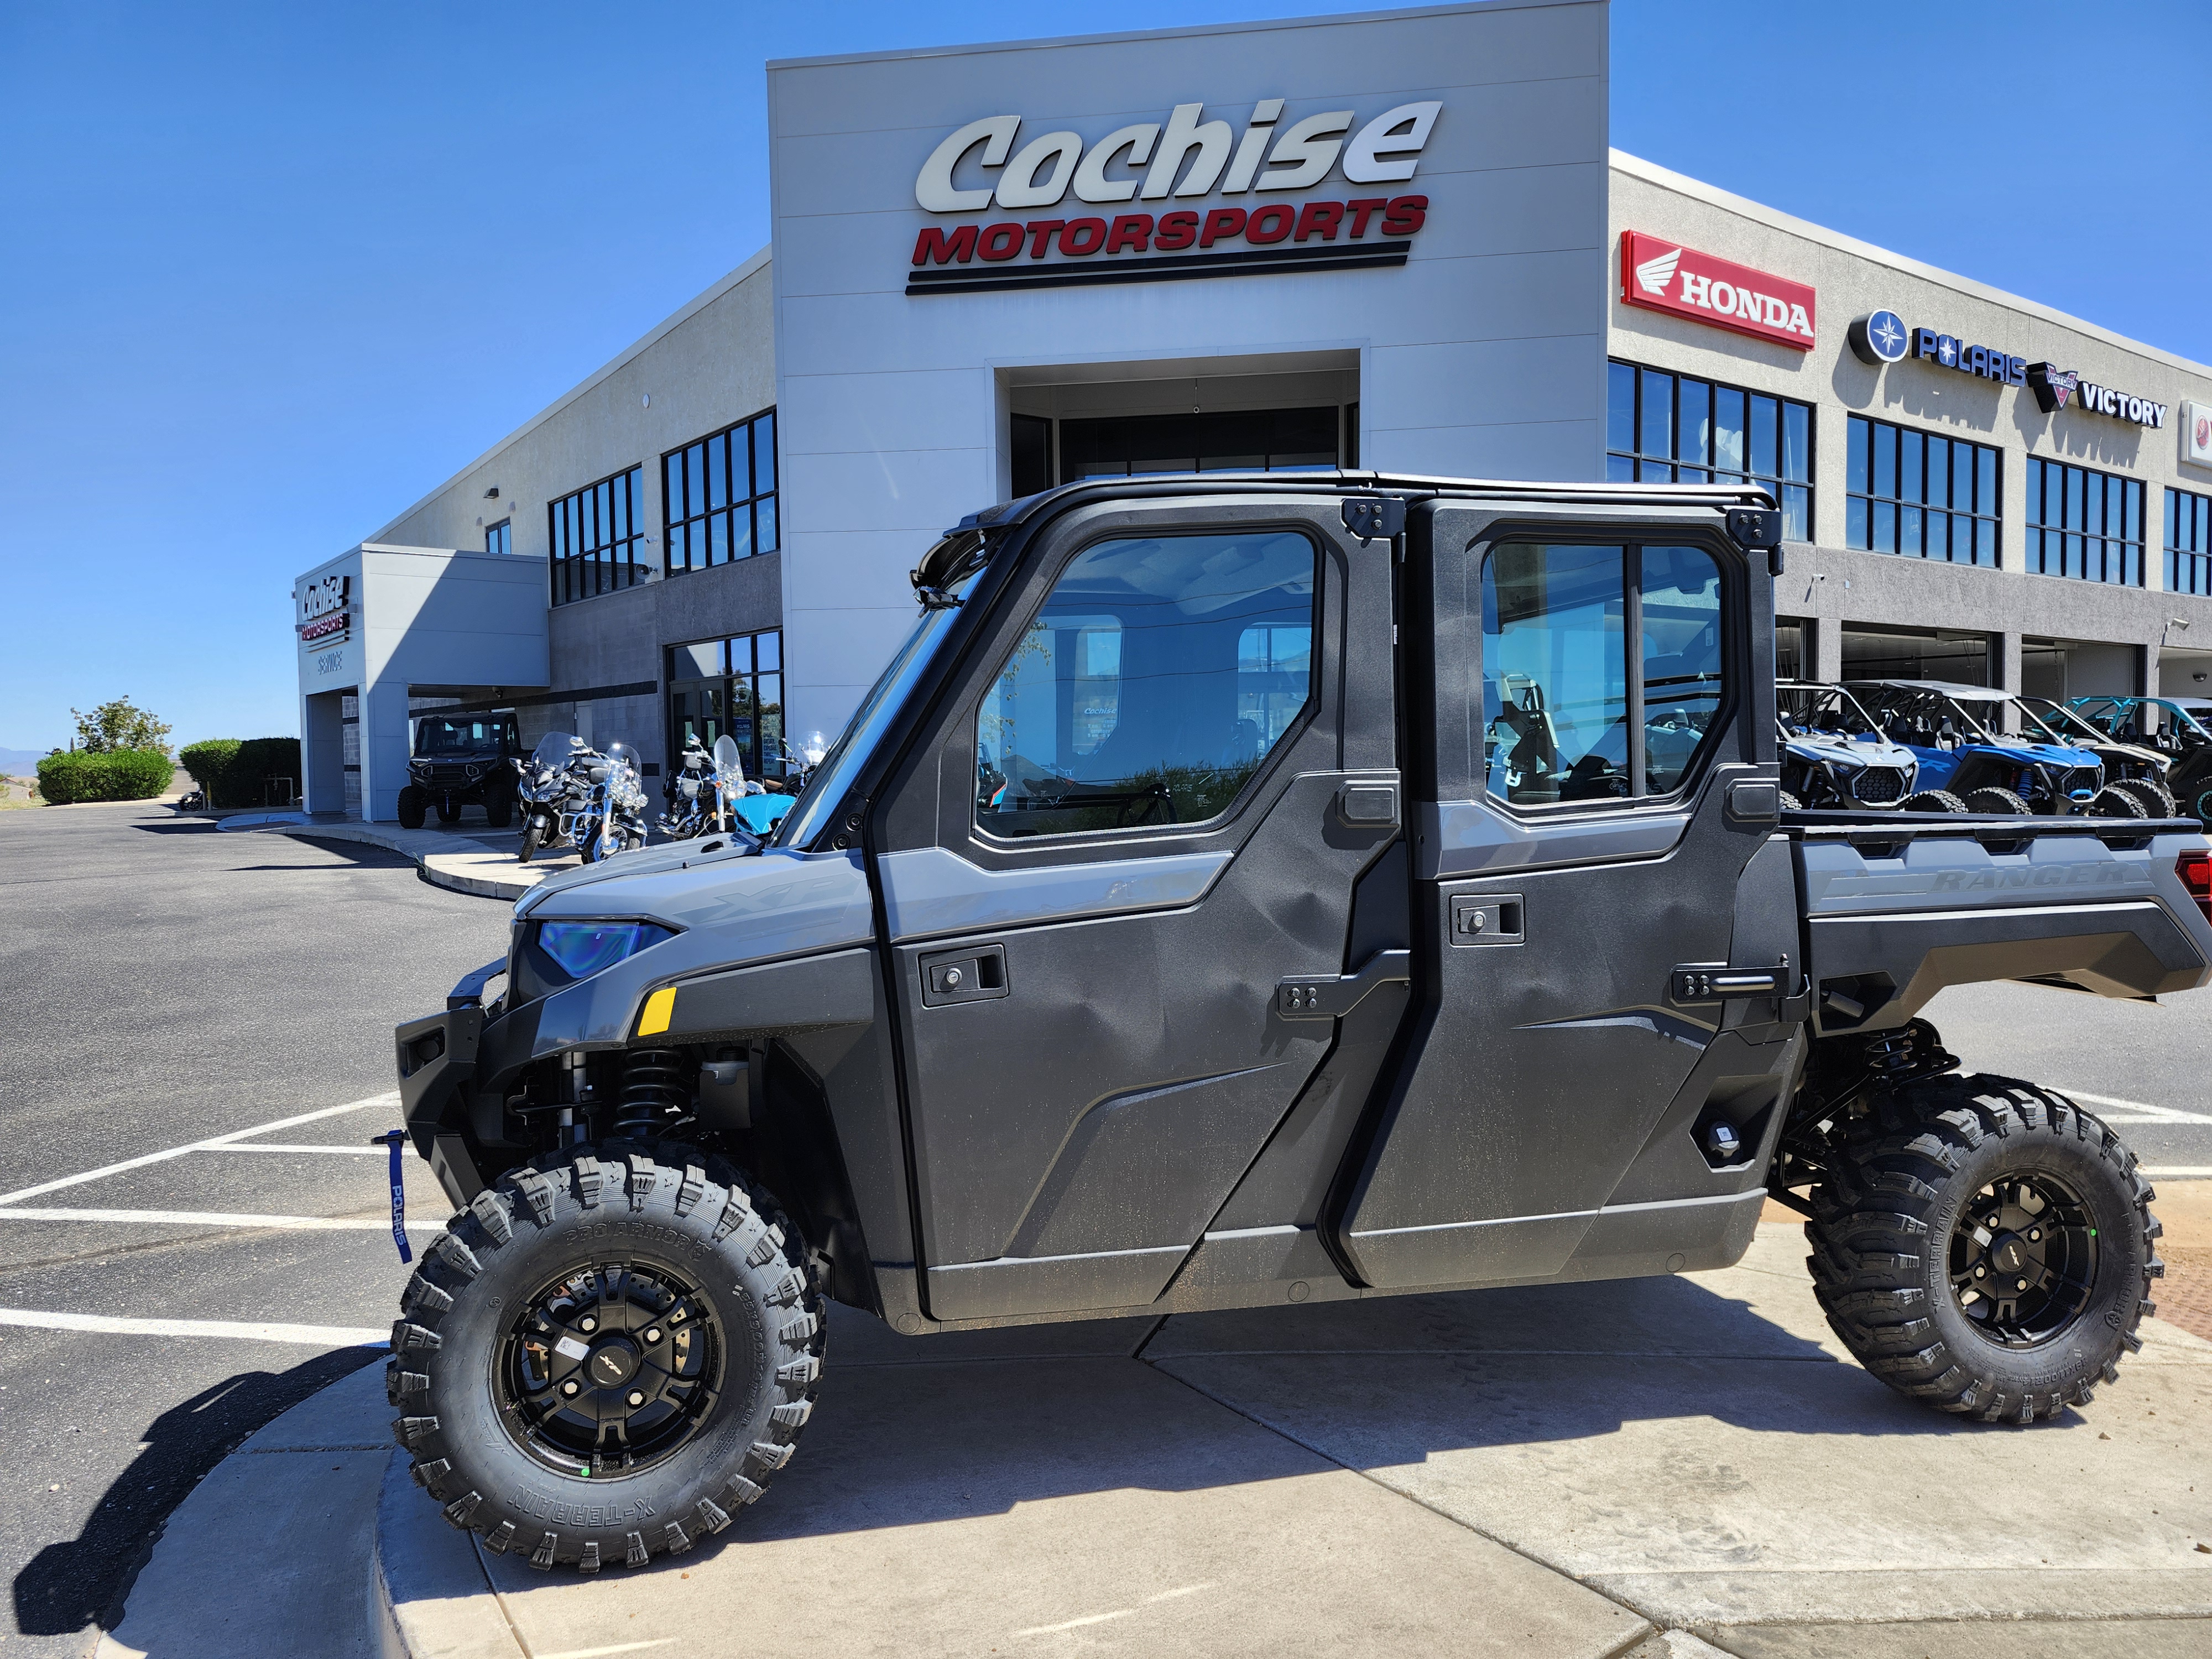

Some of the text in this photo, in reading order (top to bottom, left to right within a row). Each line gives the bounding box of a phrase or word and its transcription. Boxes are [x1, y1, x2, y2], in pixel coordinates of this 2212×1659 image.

[915, 98, 1443, 213] Cochise
[911, 195, 1429, 265] MOTORSPORTS
[1679, 270, 1814, 338] HONDA
[1913, 327, 2027, 387] POLARIS
[2047, 373, 2077, 389] VICTORY
[2080, 381, 2167, 429] VICTORY
[301, 575, 347, 622] Cochise
[302, 613, 345, 641] MOTORSPORTS
[318, 650, 342, 675] SERVICE
[698, 873, 863, 924] XP
[1929, 860, 2130, 892] RANGER
[392, 1185, 406, 1246] POLARIS
[562, 1221, 691, 1251] PRO ARMOR
[1928, 1196, 1957, 1314] X-TERRAIN
[2009, 1245, 2020, 1266] XP
[599, 1355, 622, 1375] XP
[506, 1483, 655, 1527] X-TERRAIN
